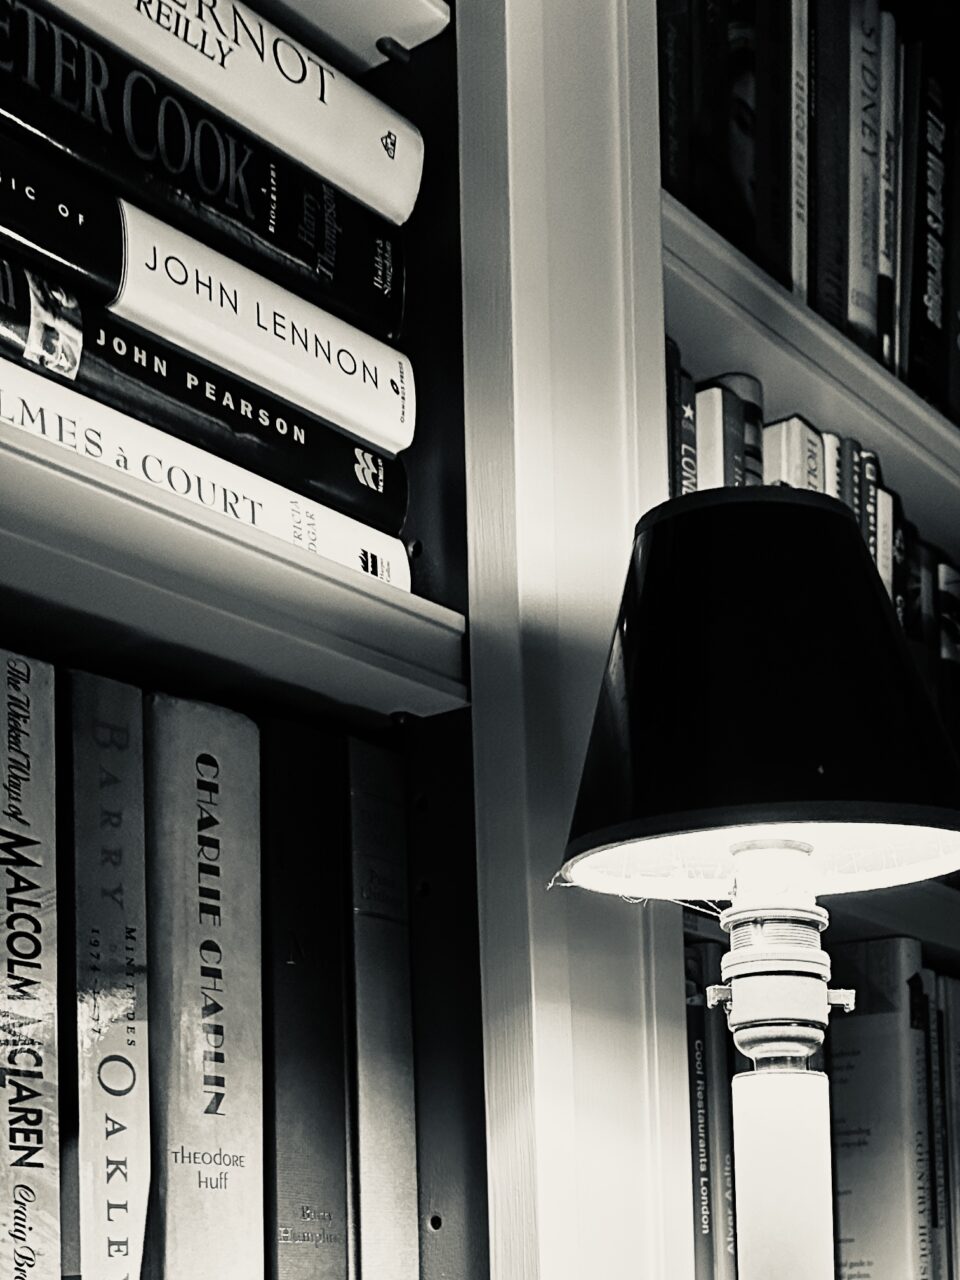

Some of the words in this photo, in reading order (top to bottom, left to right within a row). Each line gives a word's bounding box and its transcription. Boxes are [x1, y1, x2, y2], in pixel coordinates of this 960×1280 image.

[173, 0, 335, 105] RNOT
[123, 70, 256, 220] COOK
[0, 171, 36, 200] IC
[58, 202, 85, 227] OF
[267, 163, 277, 235] BIOGRAPHY
[315, 182, 345, 282] Thompson
[145, 246, 238, 315] JOHN
[256, 300, 381, 391] LENNON
[96, 328, 168, 377] JOHN
[186, 371, 306, 446] PEARSON
[115, 446, 130, 472] à
[141, 453, 264, 526] COURT
[7, 692, 31, 753] Wicked
[2, 753, 31, 802] Ways
[3, 803, 31, 828] of
[92, 721, 130, 911] BARRY
[195, 752, 222, 928] CHARLIE
[0, 827, 43, 1001] MALCOLM
[124, 926, 138, 1047] MINITDES
[199, 938, 226, 1116] CHAPLIN
[695, 1039, 704, 1075] Cool
[696, 1079, 708, 1172] Restaurants
[10, 1183, 37, 1242] Craig
[699, 1175, 711, 1234] London
